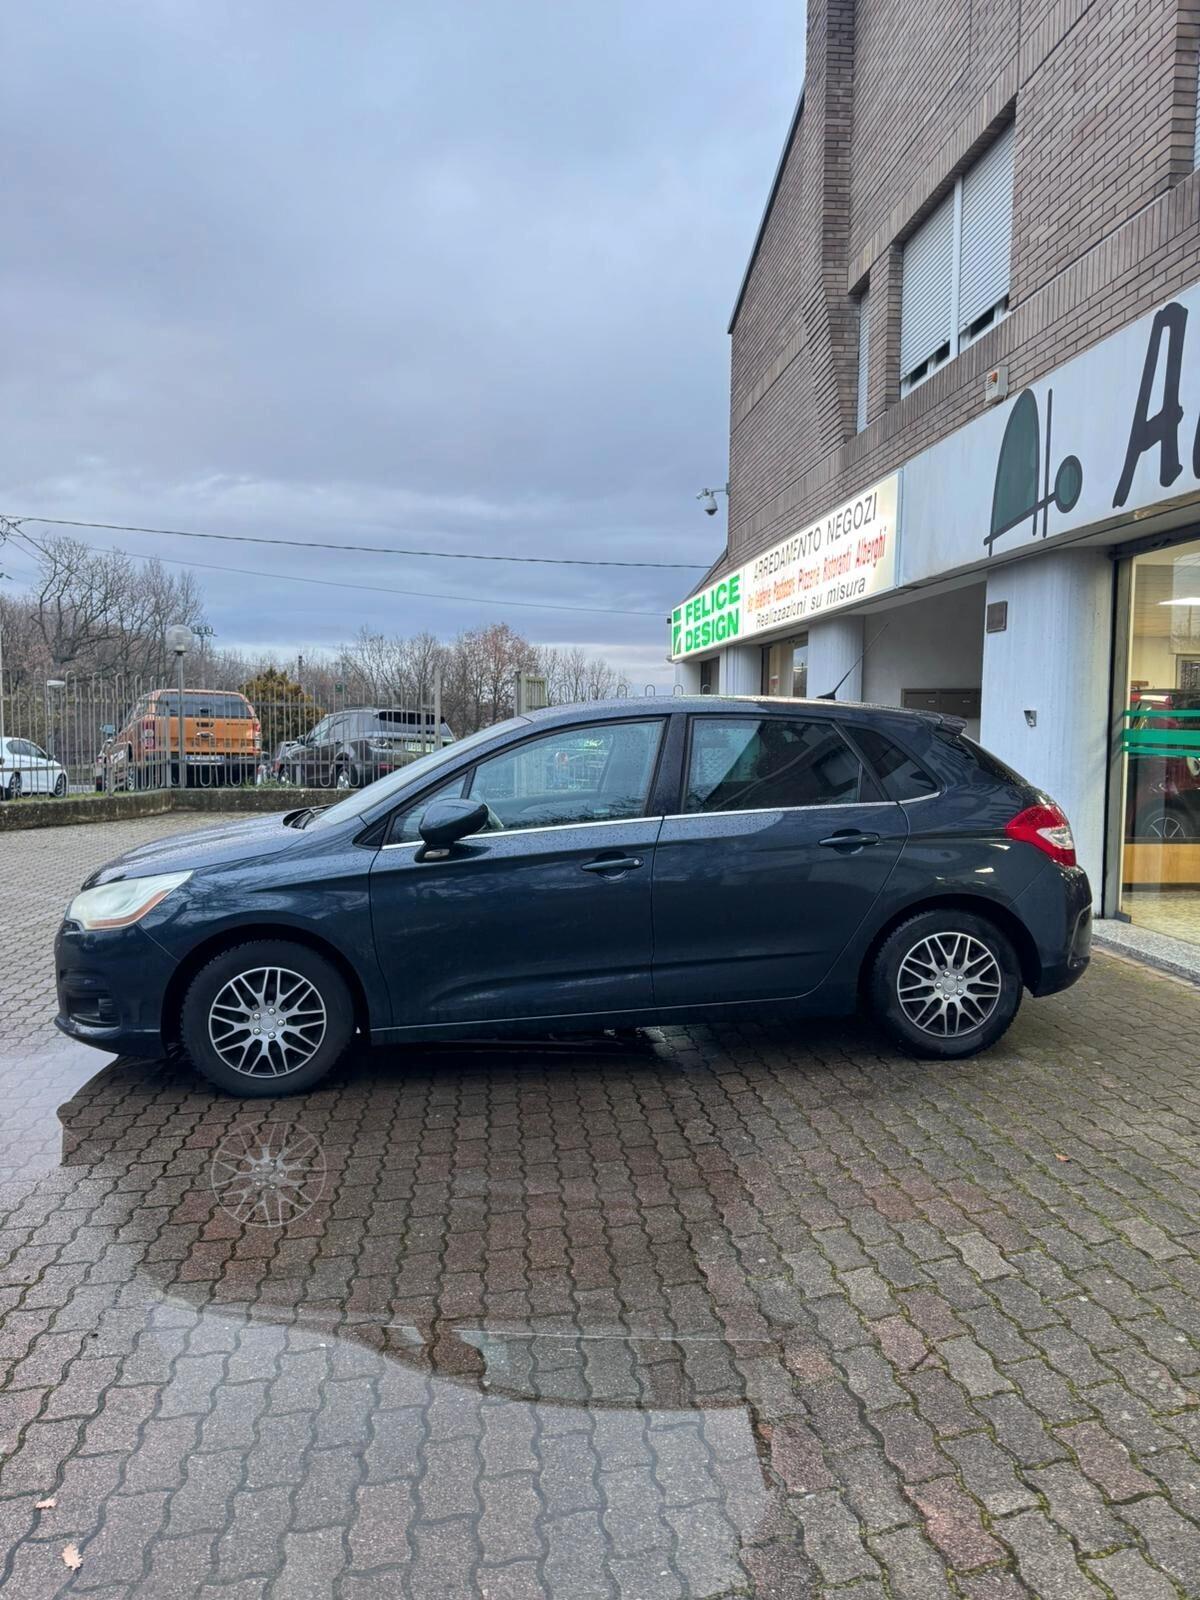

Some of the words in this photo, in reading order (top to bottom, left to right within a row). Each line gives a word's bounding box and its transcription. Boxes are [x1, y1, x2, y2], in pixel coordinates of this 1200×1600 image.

[1112, 301, 1200, 509] A
[753, 527, 822, 583] ARREDAMENTO
[827, 492, 878, 546] NEGOZI
[855, 526, 887, 568] Alberghi
[685, 573, 741, 625] FELICE
[756, 595, 807, 629] Realizzazioni
[810, 594, 822, 611] su
[826, 576, 866, 605] misura
[685, 608, 740, 652] DESIGN
